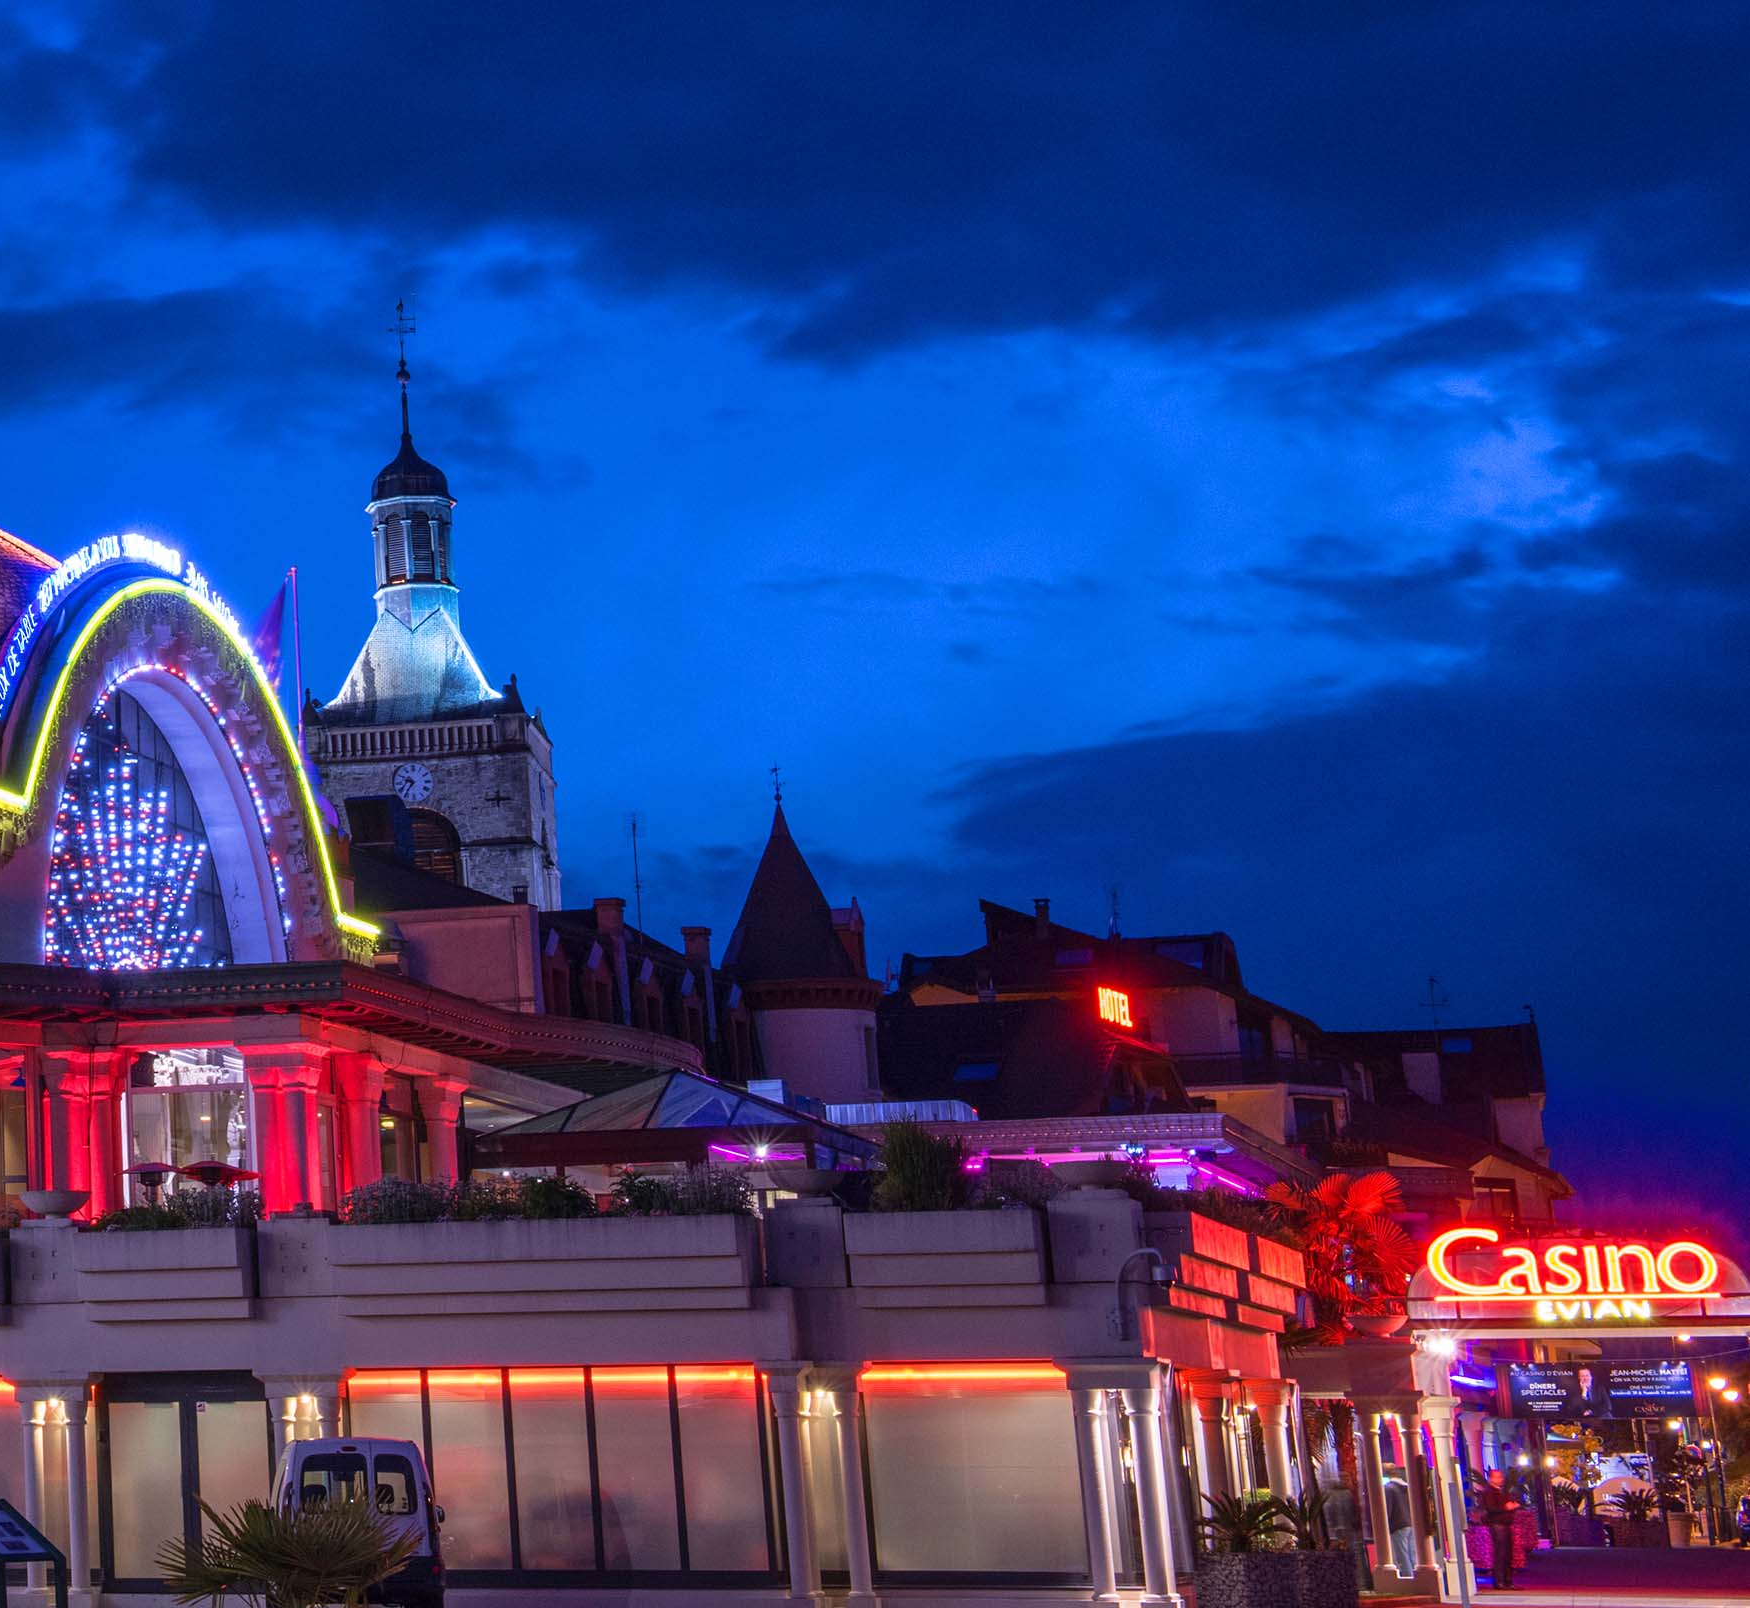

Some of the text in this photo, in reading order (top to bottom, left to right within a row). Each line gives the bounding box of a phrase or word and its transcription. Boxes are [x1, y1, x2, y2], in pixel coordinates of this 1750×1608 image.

[7, 646, 20, 676] DE
[14, 604, 38, 653] TABLE
[1098, 987, 1133, 1027] HOTEL
[1427, 1227, 1718, 1294] Casino
[1535, 1300, 1651, 1321] EVIAN
